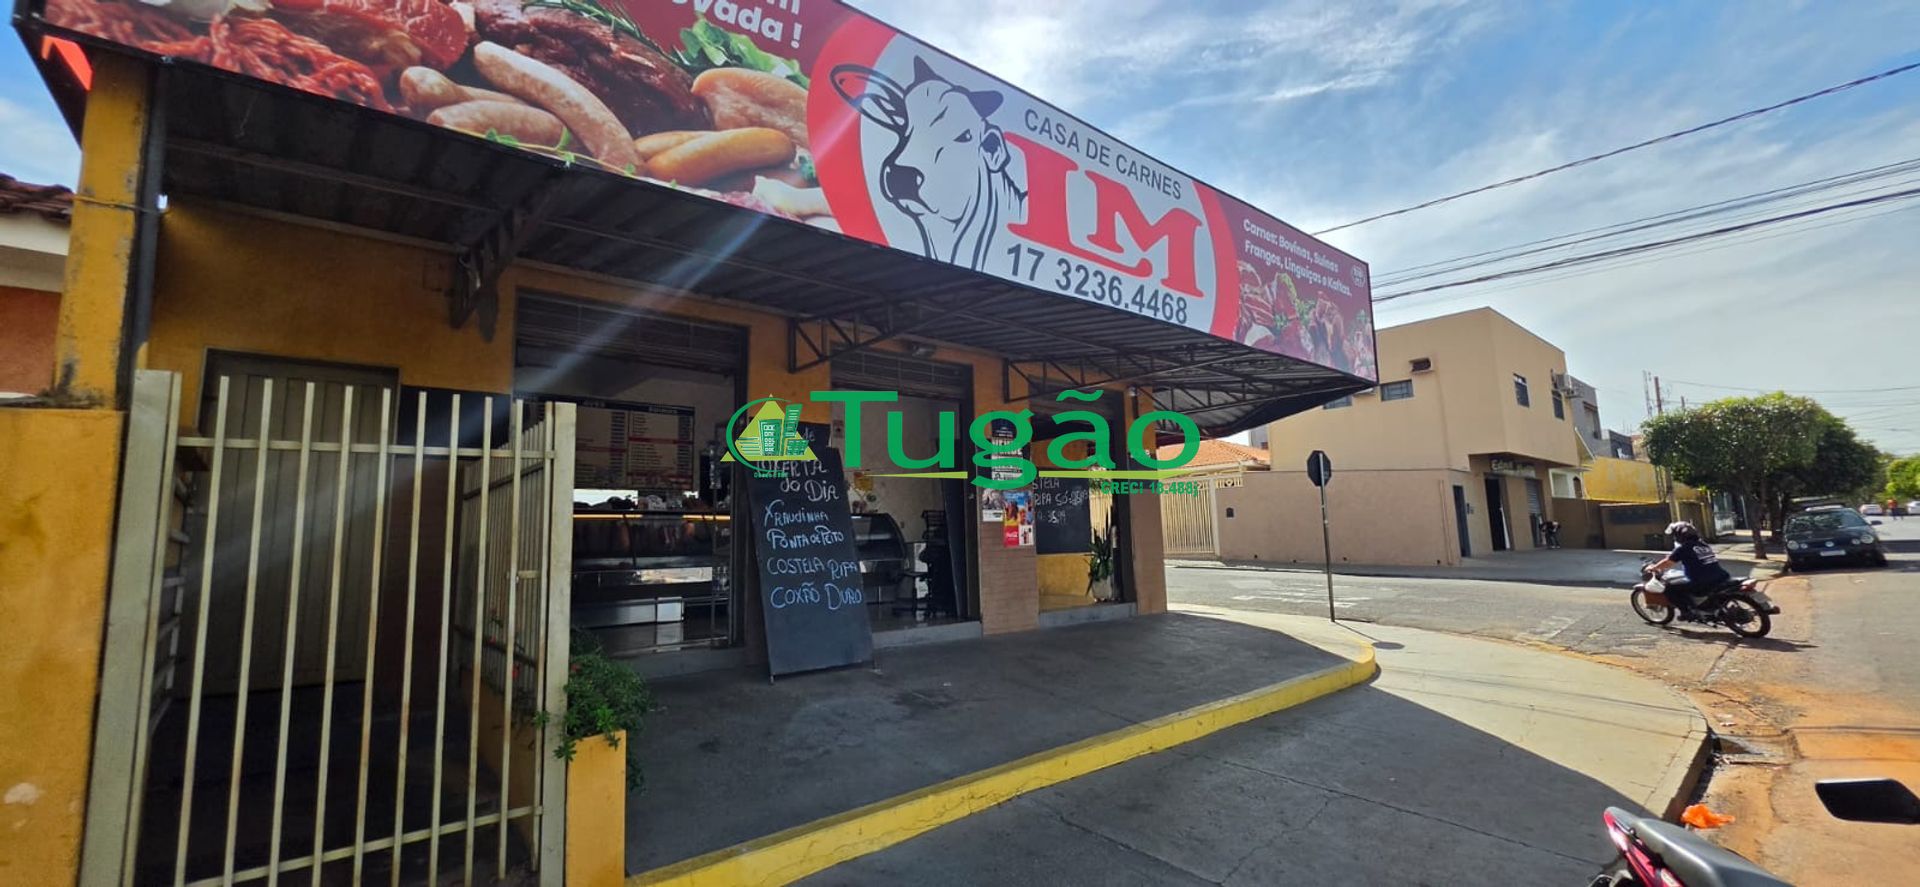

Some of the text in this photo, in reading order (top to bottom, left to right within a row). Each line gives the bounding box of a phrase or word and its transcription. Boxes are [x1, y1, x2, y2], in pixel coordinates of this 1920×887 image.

[1024, 108, 1181, 200] CASA DE CARNES
[1245, 240, 1283, 269] Frangos,
[1006, 243, 1187, 325] 17 3236.4468
[767, 528, 810, 549] PONTA
[814, 525, 844, 546] PEITO
[766, 556, 858, 580] COSTELA RIPA
[770, 581, 862, 610] COXÃO DURO
